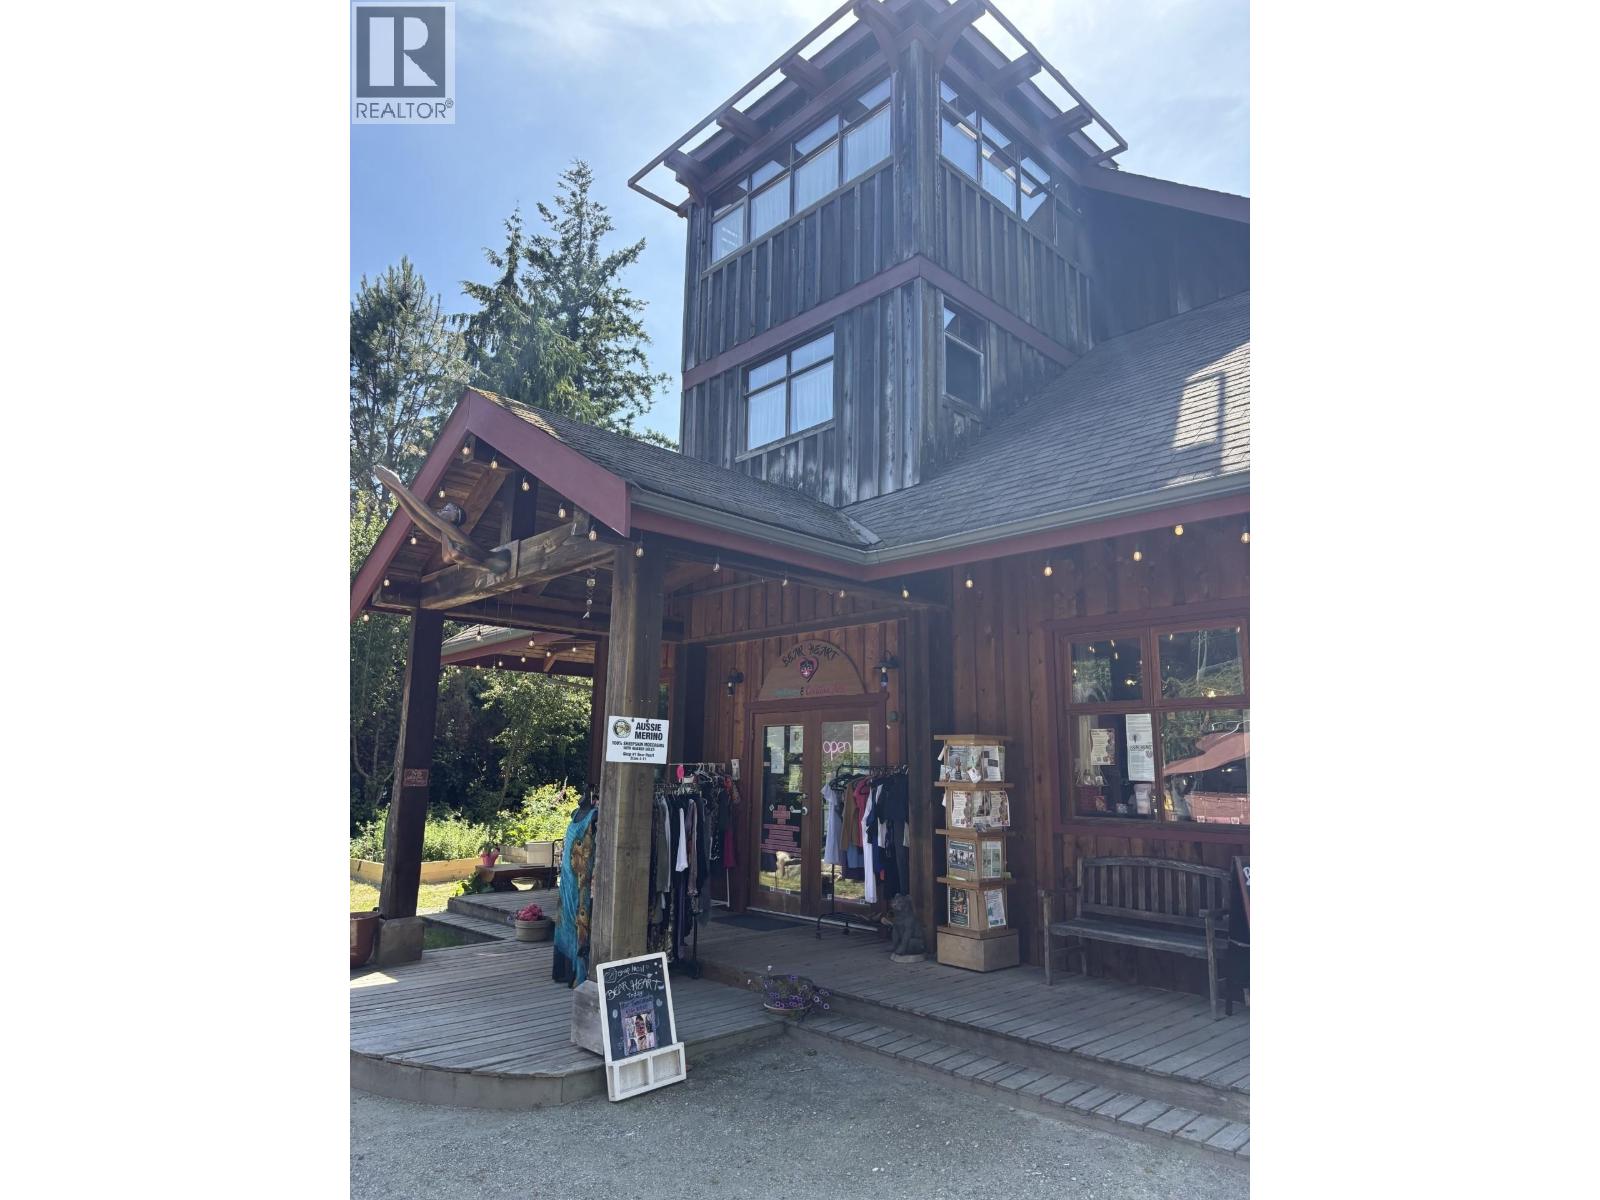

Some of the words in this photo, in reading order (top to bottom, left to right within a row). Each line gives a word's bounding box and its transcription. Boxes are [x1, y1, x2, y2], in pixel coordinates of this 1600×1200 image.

[782, 645, 805, 668] BEAR
[808, 643, 839, 660] HEART
[634, 731, 663, 740] MERINO
[636, 722, 661, 731] AUSSIE
[823, 741, 852, 761] open
[605, 981, 631, 1000] BEAR
[630, 978, 663, 992] HEART
